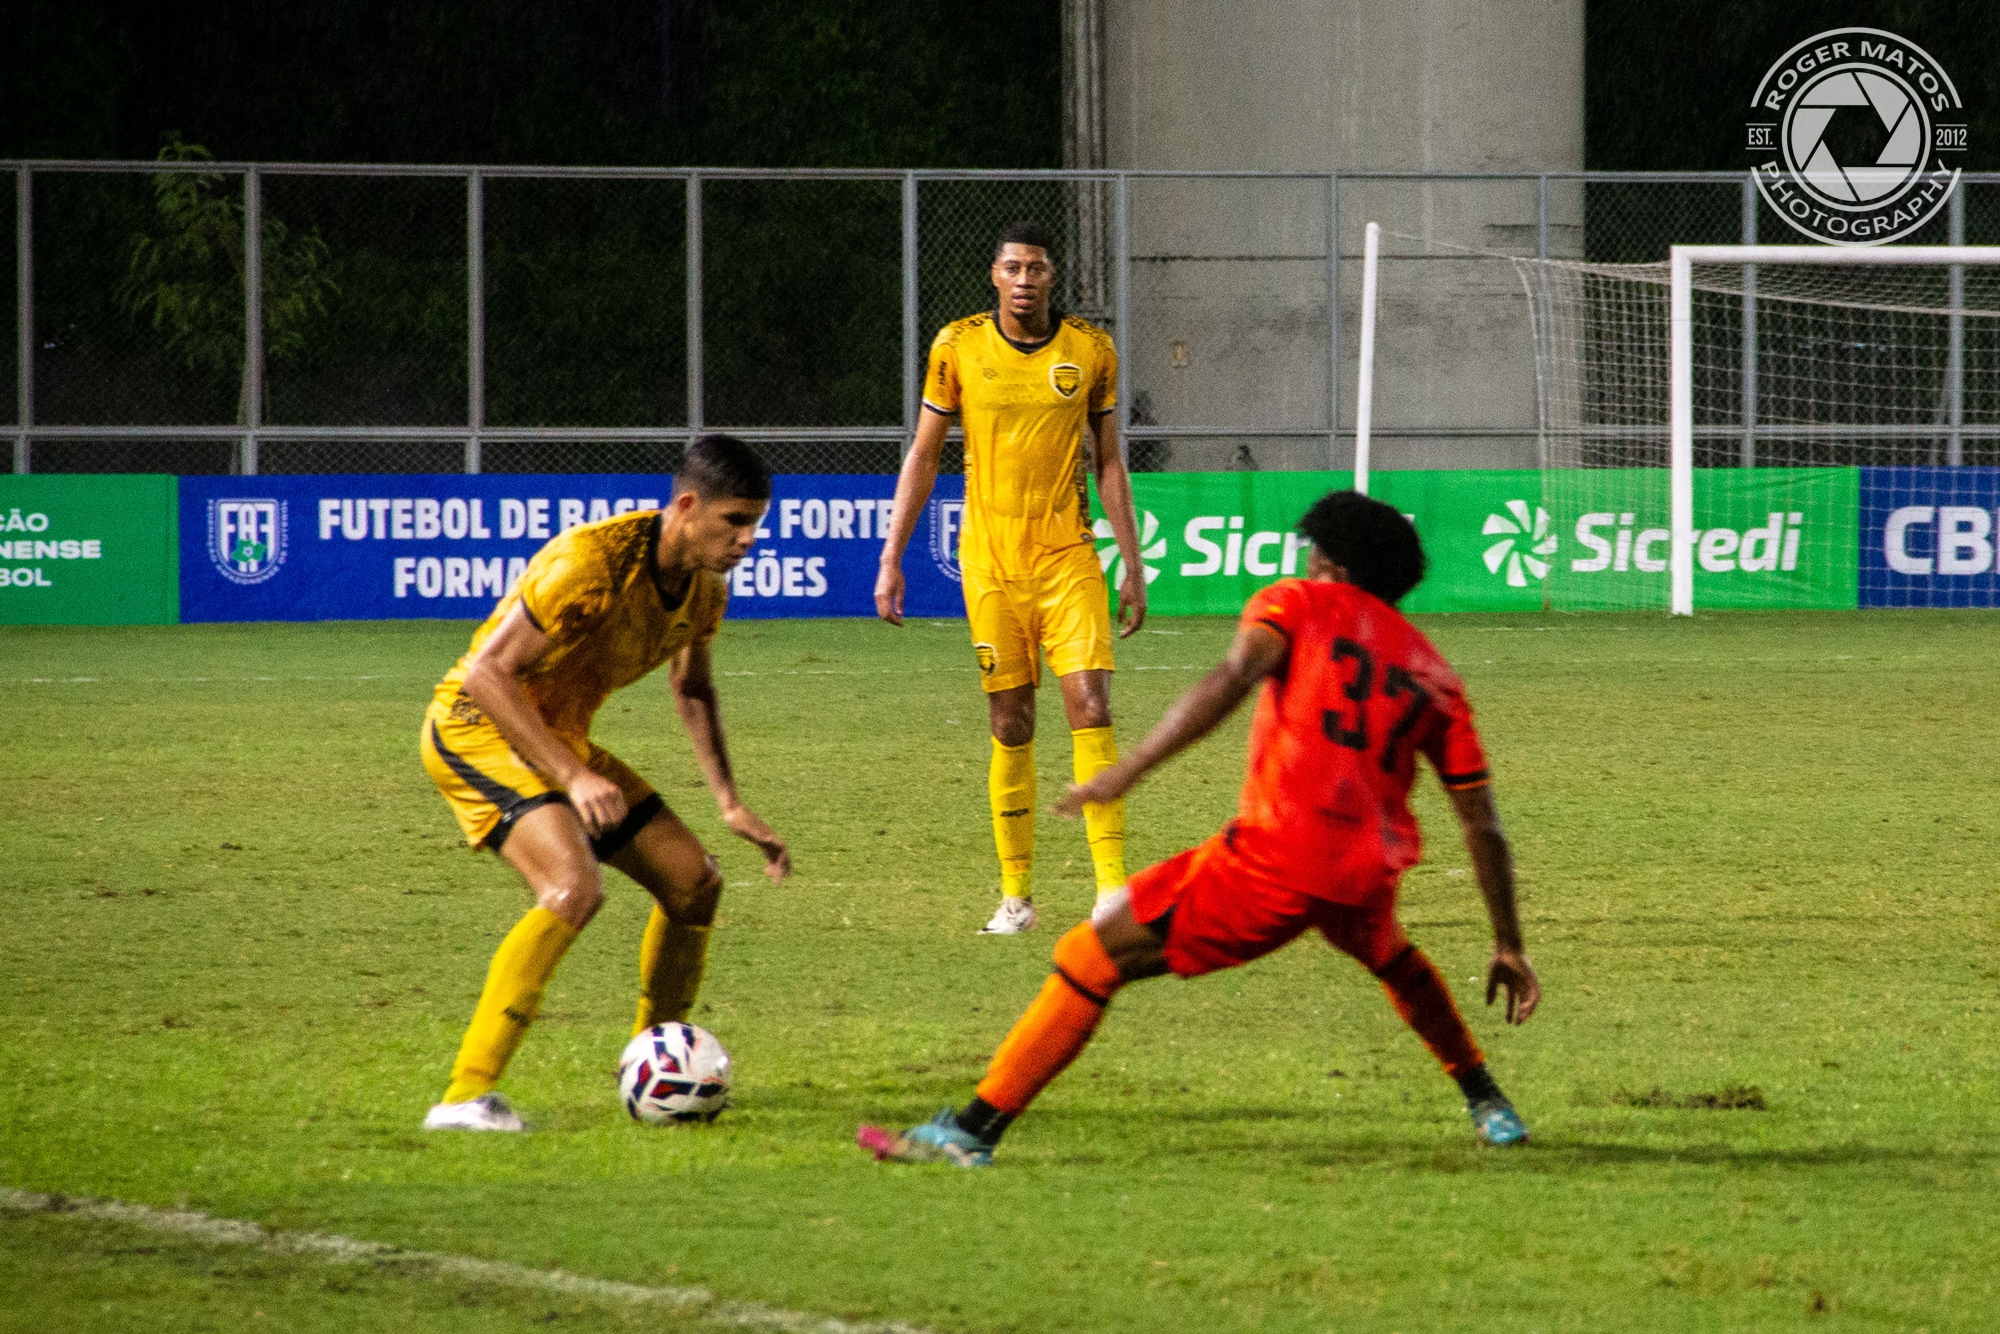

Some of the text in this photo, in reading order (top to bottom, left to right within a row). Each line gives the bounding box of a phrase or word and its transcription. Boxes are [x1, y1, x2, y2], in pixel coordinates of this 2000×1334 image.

[0, 508, 49, 532] ÃO
[318, 498, 490, 540] FUTEBOL
[500, 498, 550, 539] DE
[559, 498, 660, 533] BA
[780, 498, 895, 540] FORTE
[1180, 515, 1313, 577] Sicr
[1884, 506, 2000, 575] CB
[728, 548, 828, 597] EÕES
[1322, 636, 1430, 774] 37
